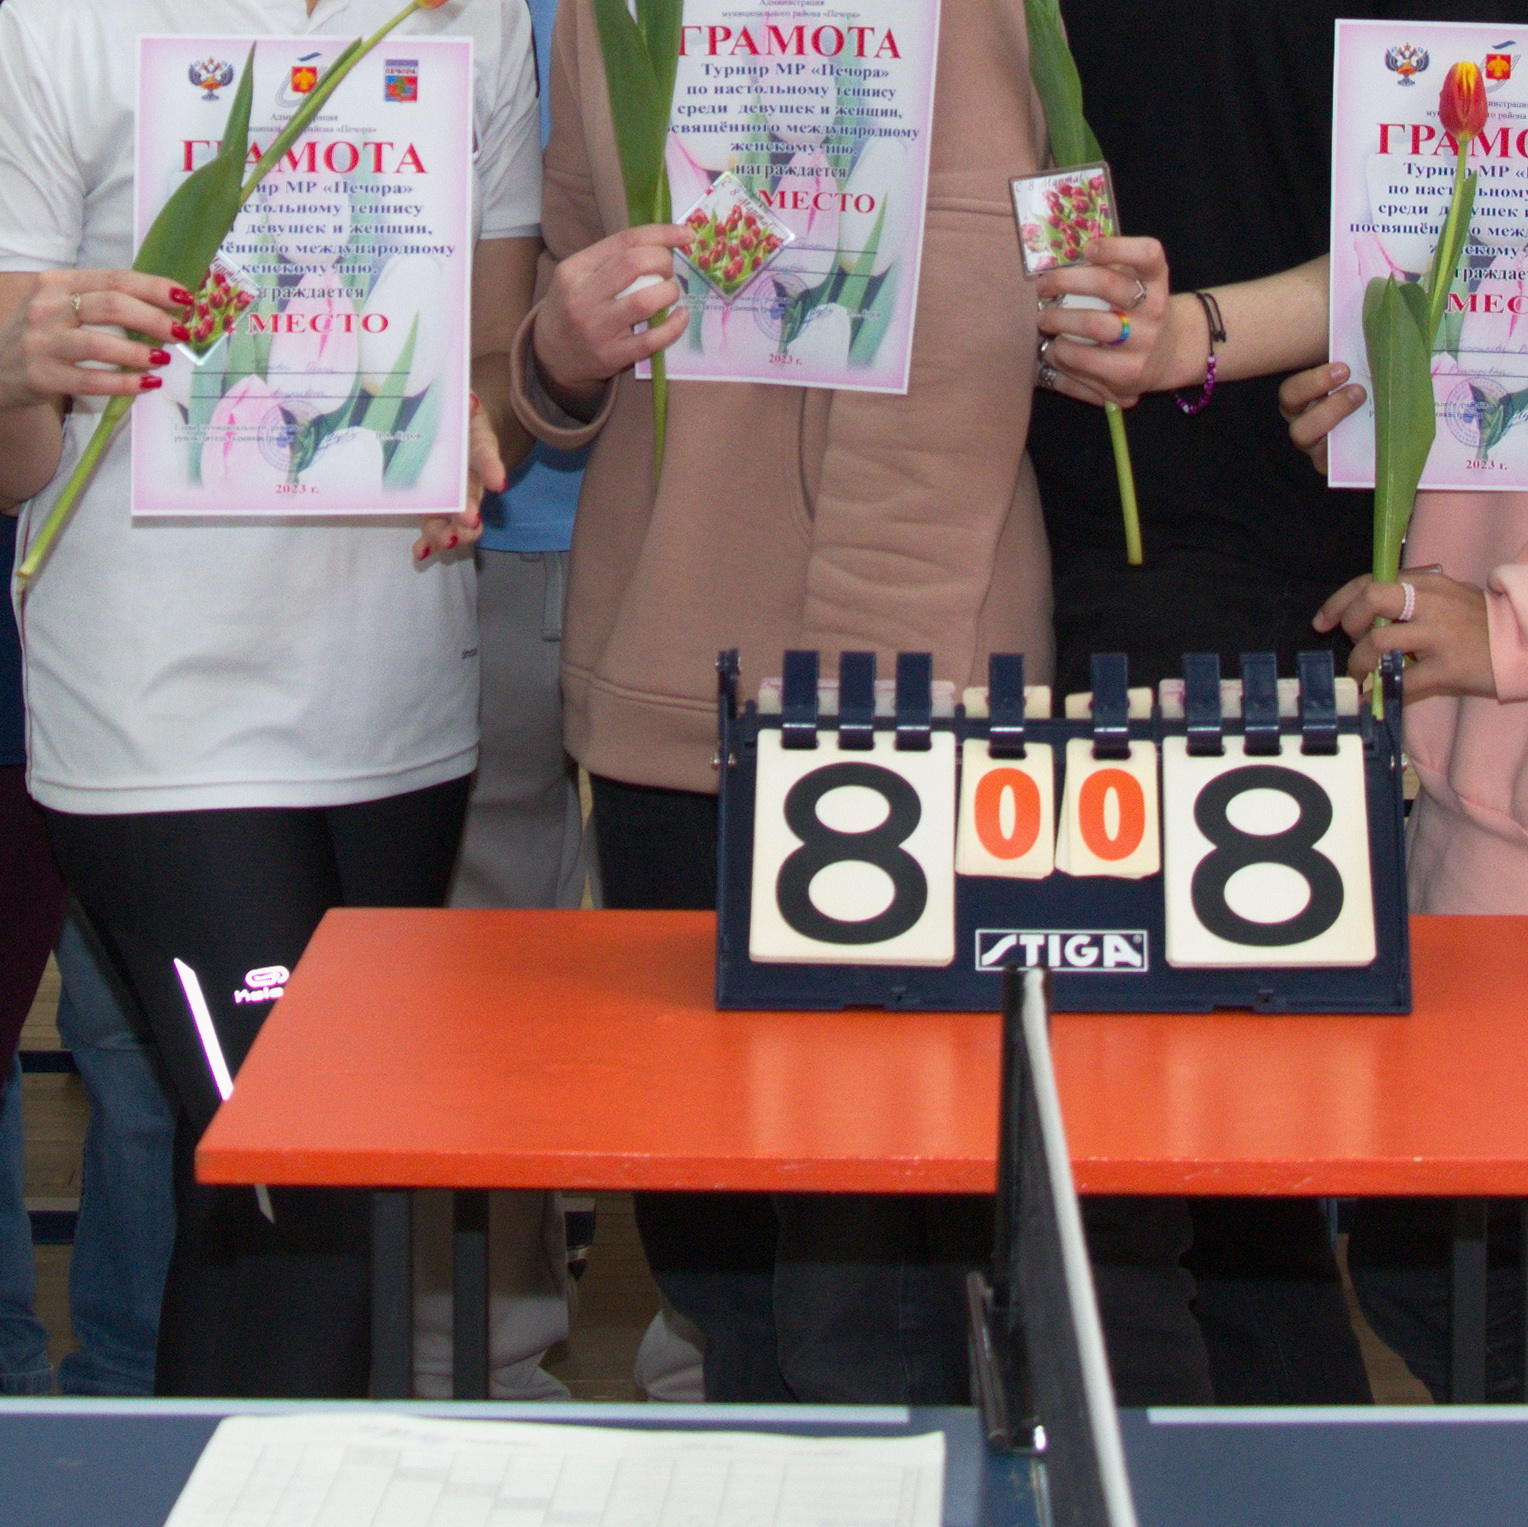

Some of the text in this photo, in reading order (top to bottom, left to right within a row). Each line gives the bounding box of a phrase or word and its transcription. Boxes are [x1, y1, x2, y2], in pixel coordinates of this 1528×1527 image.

[678, 24, 902, 60] ГРАМОТА
[700, 63, 889, 81] Турнир МР «Печора»
[687, 84, 896, 102] по настольному теннису
[677, 103, 901, 121] среди девушек и женщин,
[668, 121, 917, 142] свящённого международному
[730, 141, 858, 157] женскому дню.
[735, 163, 846, 178] награждается
[1478, 165, 1510, 178] МР
[284, 181, 317, 193] МР
[323, 181, 413, 197] «Печора»
[1388, 184, 1409, 194] по
[240, 202, 423, 218] стольному теннису
[1379, 203, 1429, 216] среди
[1439, 204, 1518, 219] душек
[245, 223, 432, 237] девушек и женщин,
[1351, 222, 1481, 238] посвящёно
[295, 242, 456, 258] международному
[331, 263, 377, 276] дню.
[249, 312, 388, 334] МЕСТО
[768, 353, 794, 365] 2023
[1465, 459, 1496, 470] 2023
[275, 484, 307, 494] 2023
[777, 761, 1344, 947] 8 0 0 8
